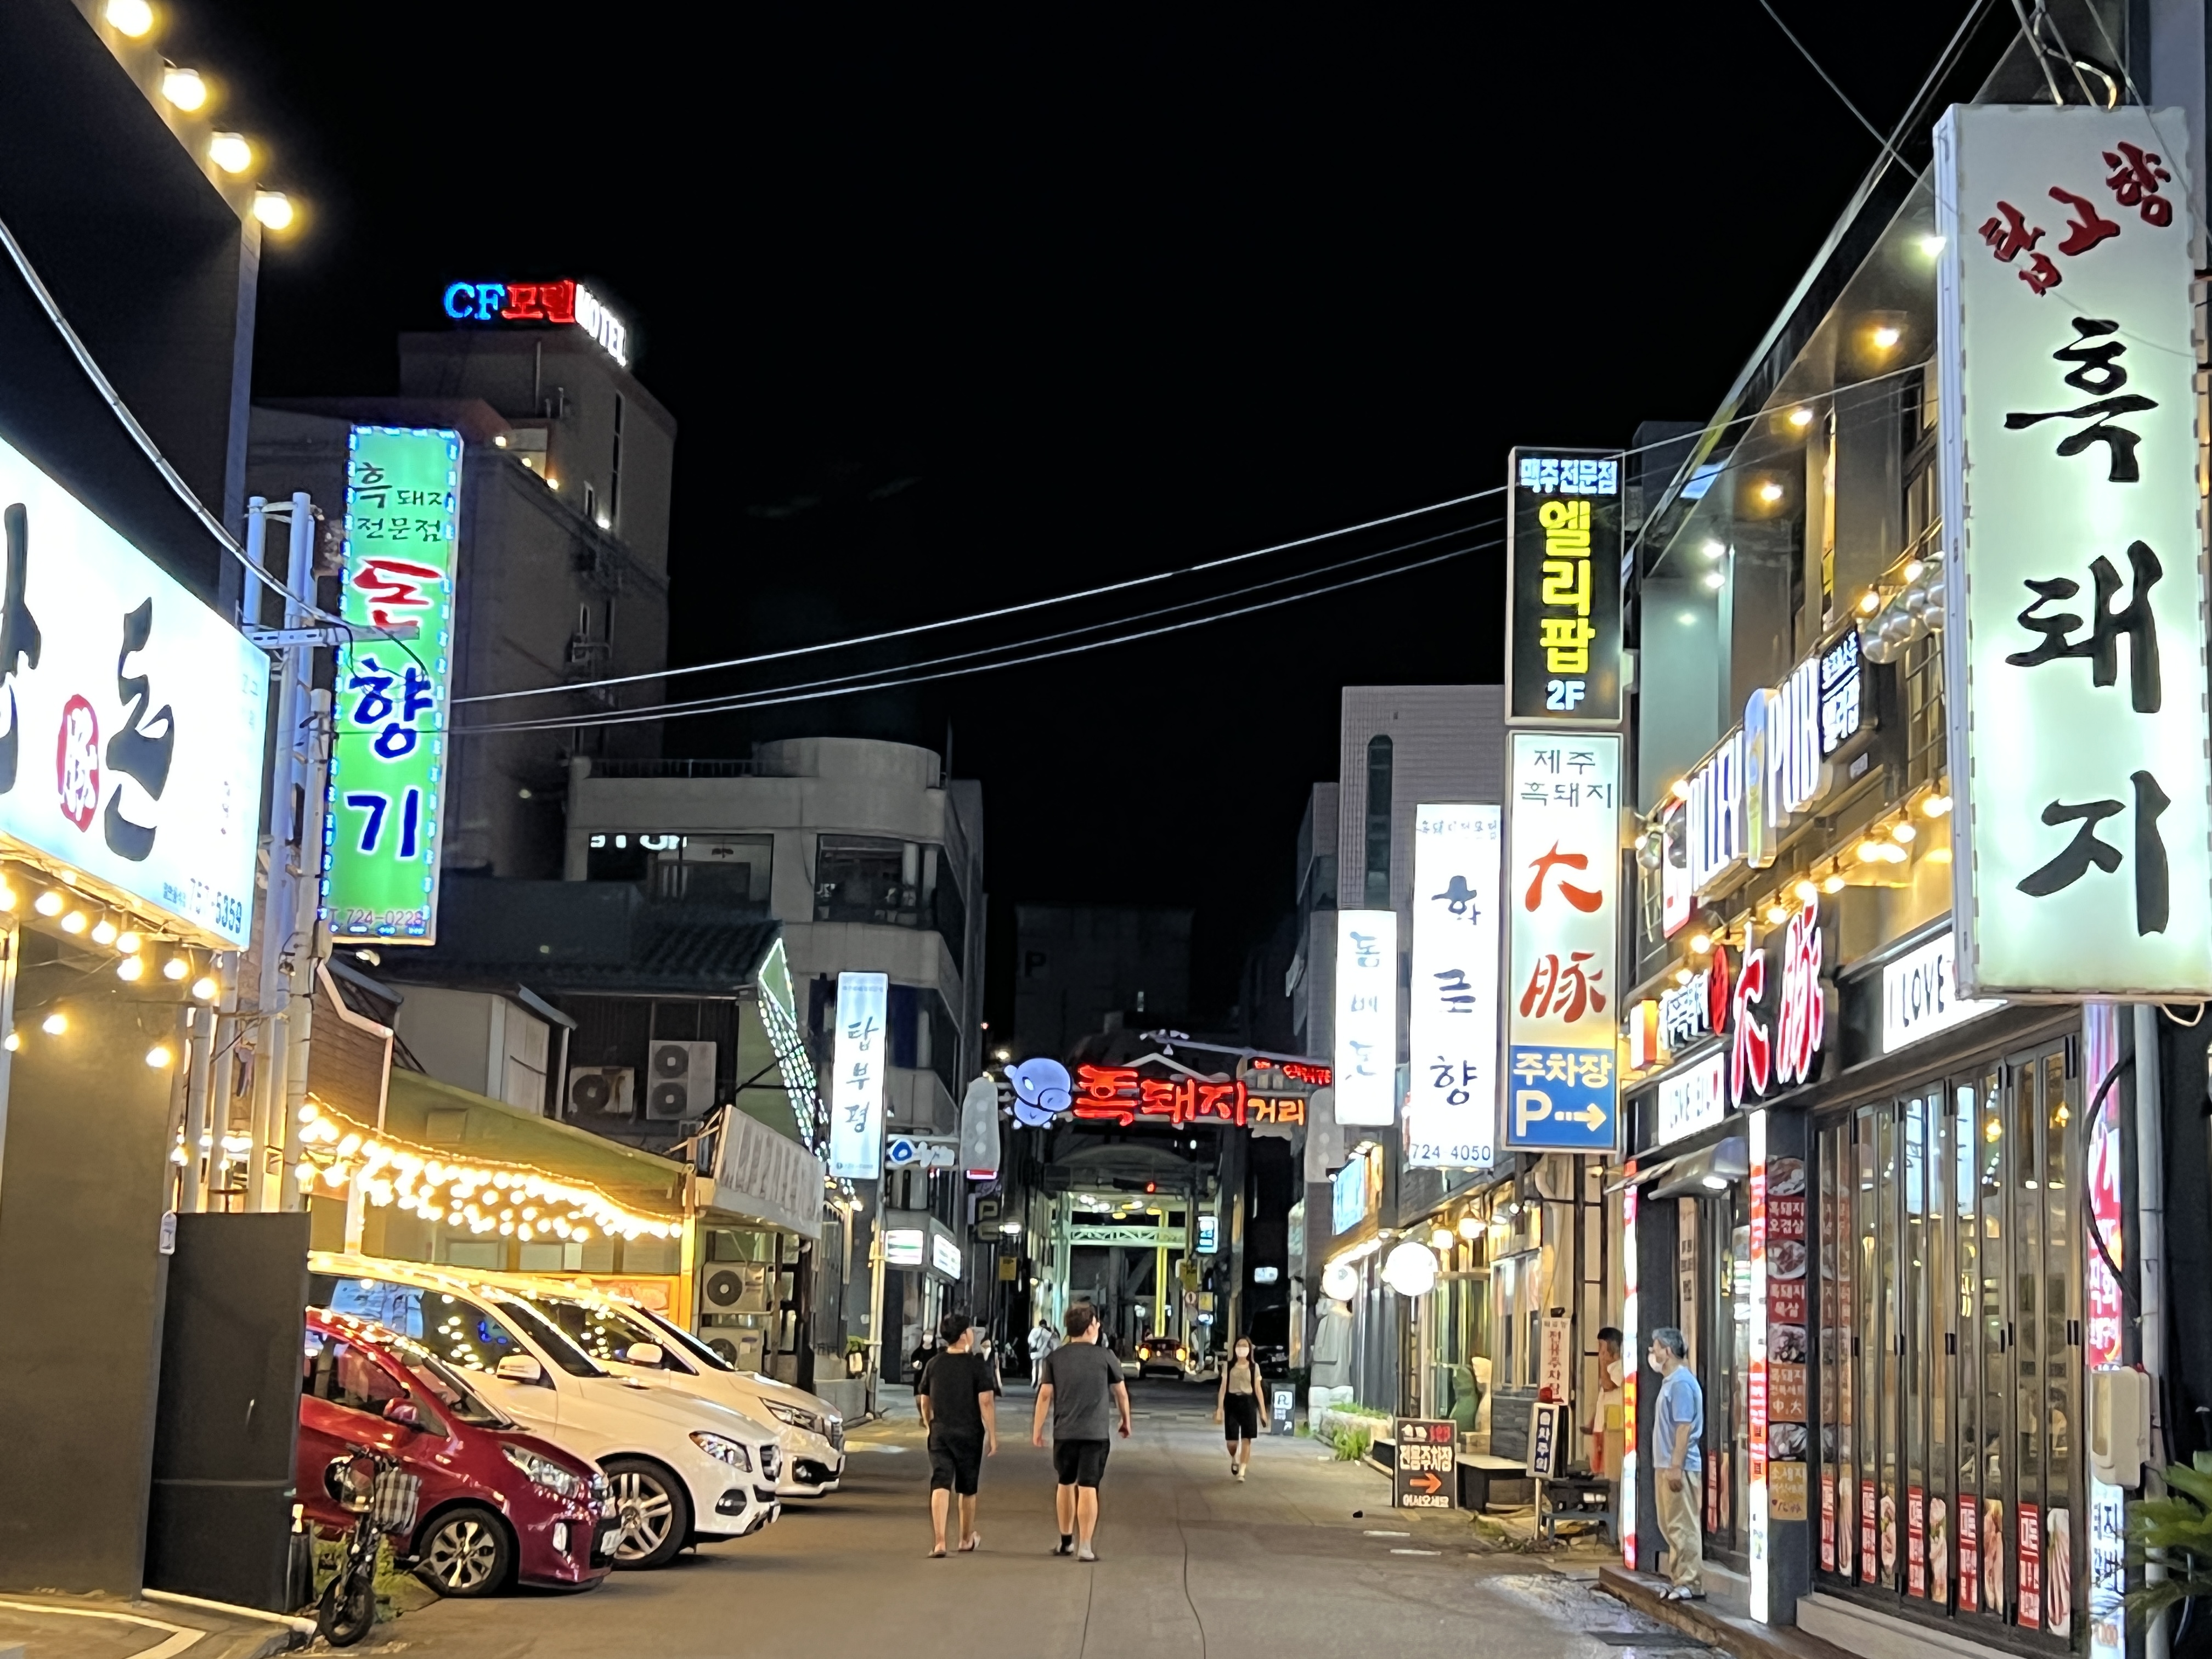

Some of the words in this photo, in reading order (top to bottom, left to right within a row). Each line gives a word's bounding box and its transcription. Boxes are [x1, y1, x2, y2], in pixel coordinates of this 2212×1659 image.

[1520, 458, 1618, 494] 맥주전문점
[357, 518, 442, 542] 전문점
[2004, 317, 2170, 936] 흑돼지
[344, 557, 442, 860] 돈향기
[1546, 680, 1585, 711] 2F
[1533, 749, 1596, 775] 제주
[1520, 782, 1612, 808] 흑돼지
[1903, 954, 1944, 1028] LOVE
[1513, 1053, 1613, 1088] 주차장
[1074, 1063, 1248, 1127] 흑돼지
[1248, 1098, 1305, 1126] 거리
[1516, 1090, 1553, 1137] P
[1411, 1143, 1441, 1160] 724
[1451, 1144, 1491, 1161] 4050
